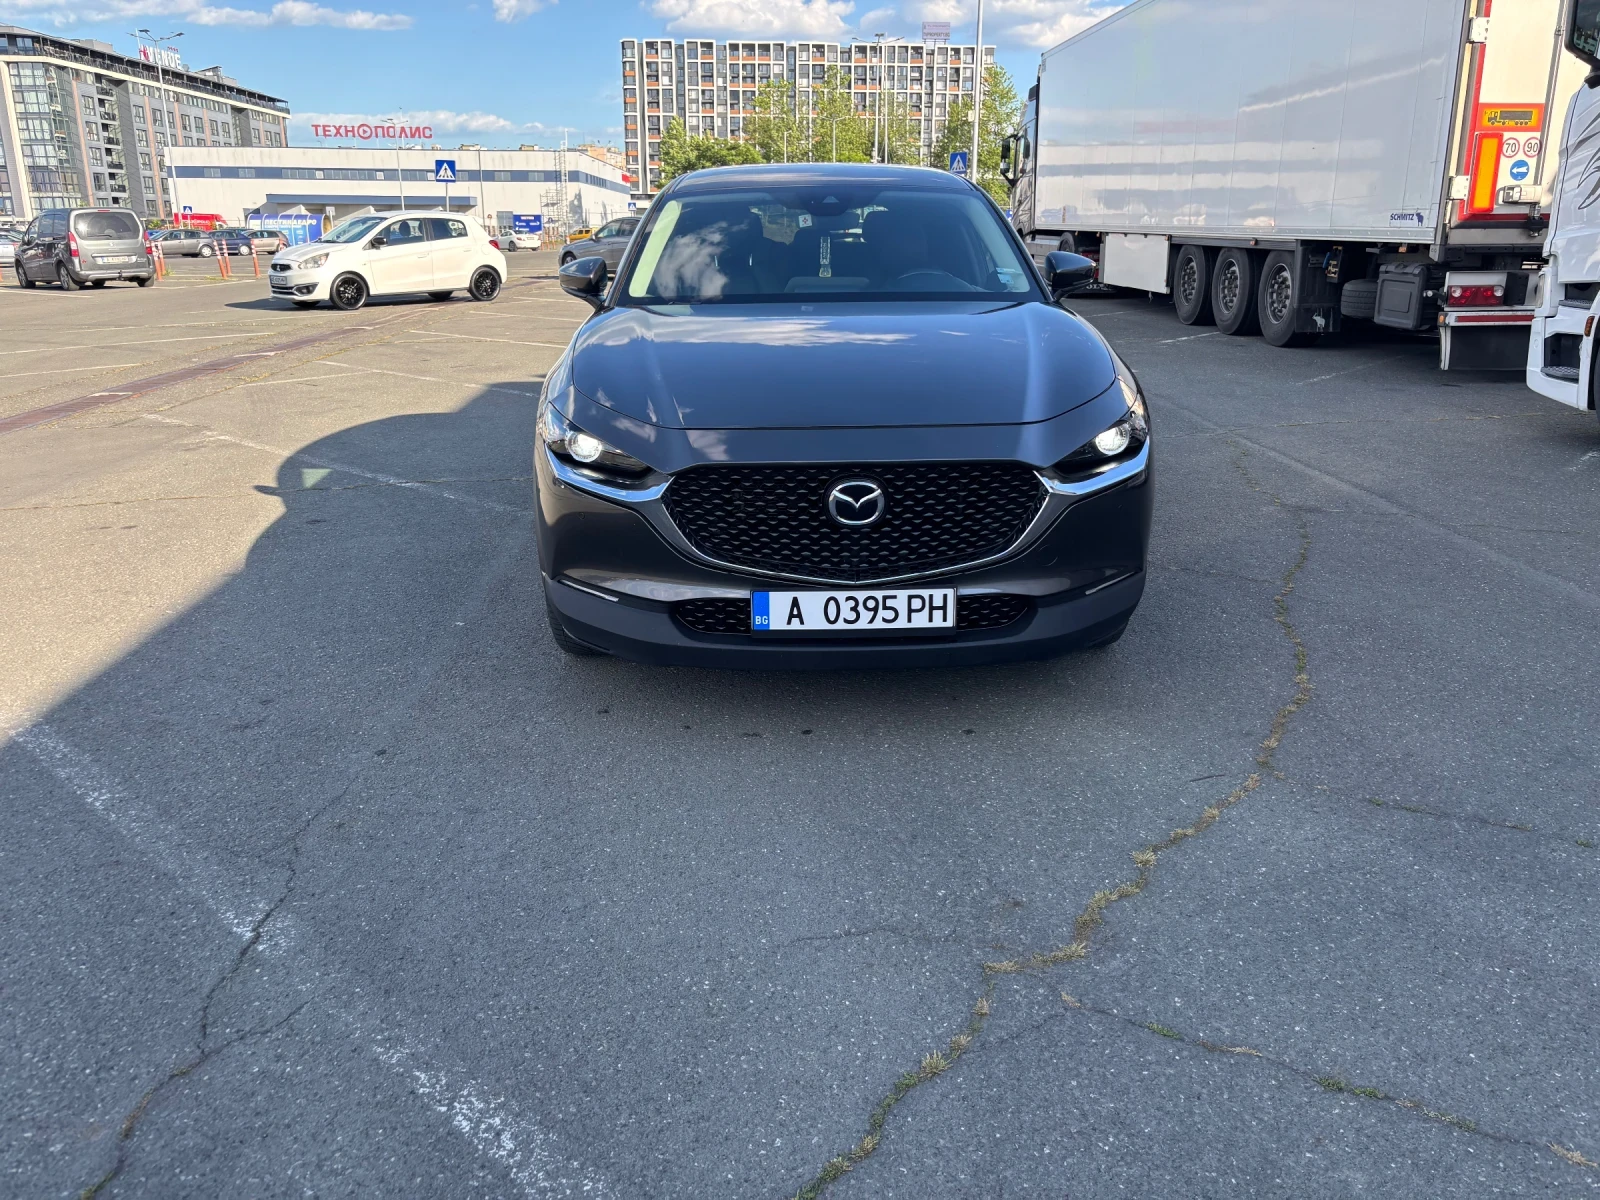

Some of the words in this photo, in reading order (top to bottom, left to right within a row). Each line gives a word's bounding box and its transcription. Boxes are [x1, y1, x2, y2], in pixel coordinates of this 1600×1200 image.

[311, 123, 433, 140] ТЕХНОПОЛИС
[1505, 142, 1517, 154] 70
[1526, 142, 1539, 153] 90
[1390, 213, 1415, 221] SCHMITZ
[786, 596, 805, 626] A
[823, 595, 899, 625] 0395
[907, 593, 948, 624] PH
[755, 615, 769, 625] BG
